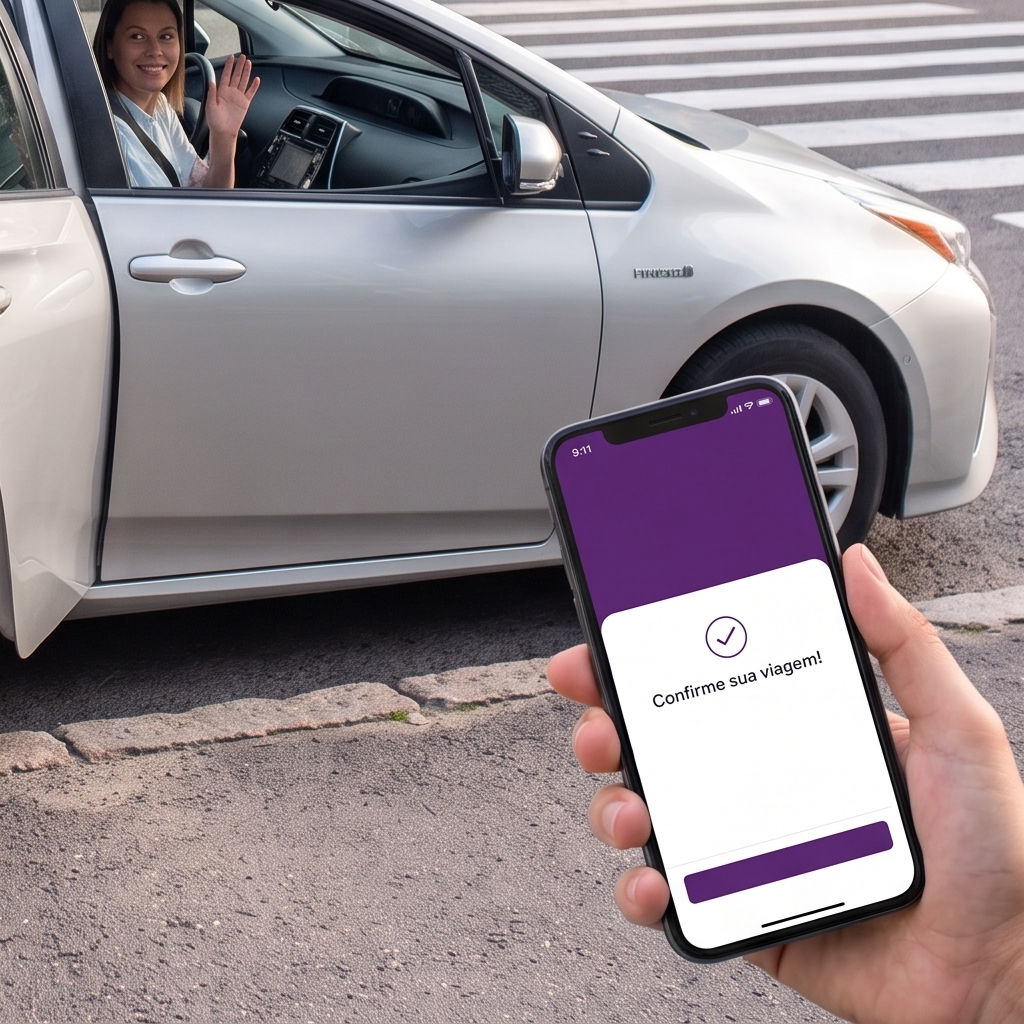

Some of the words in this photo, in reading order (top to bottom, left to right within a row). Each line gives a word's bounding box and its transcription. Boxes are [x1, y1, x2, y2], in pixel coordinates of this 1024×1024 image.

[571, 444, 592, 458] 9:11
[652, 679, 726, 708] Confirme
[729, 671, 758, 687] sua
[759, 650, 823, 678] viagem!
